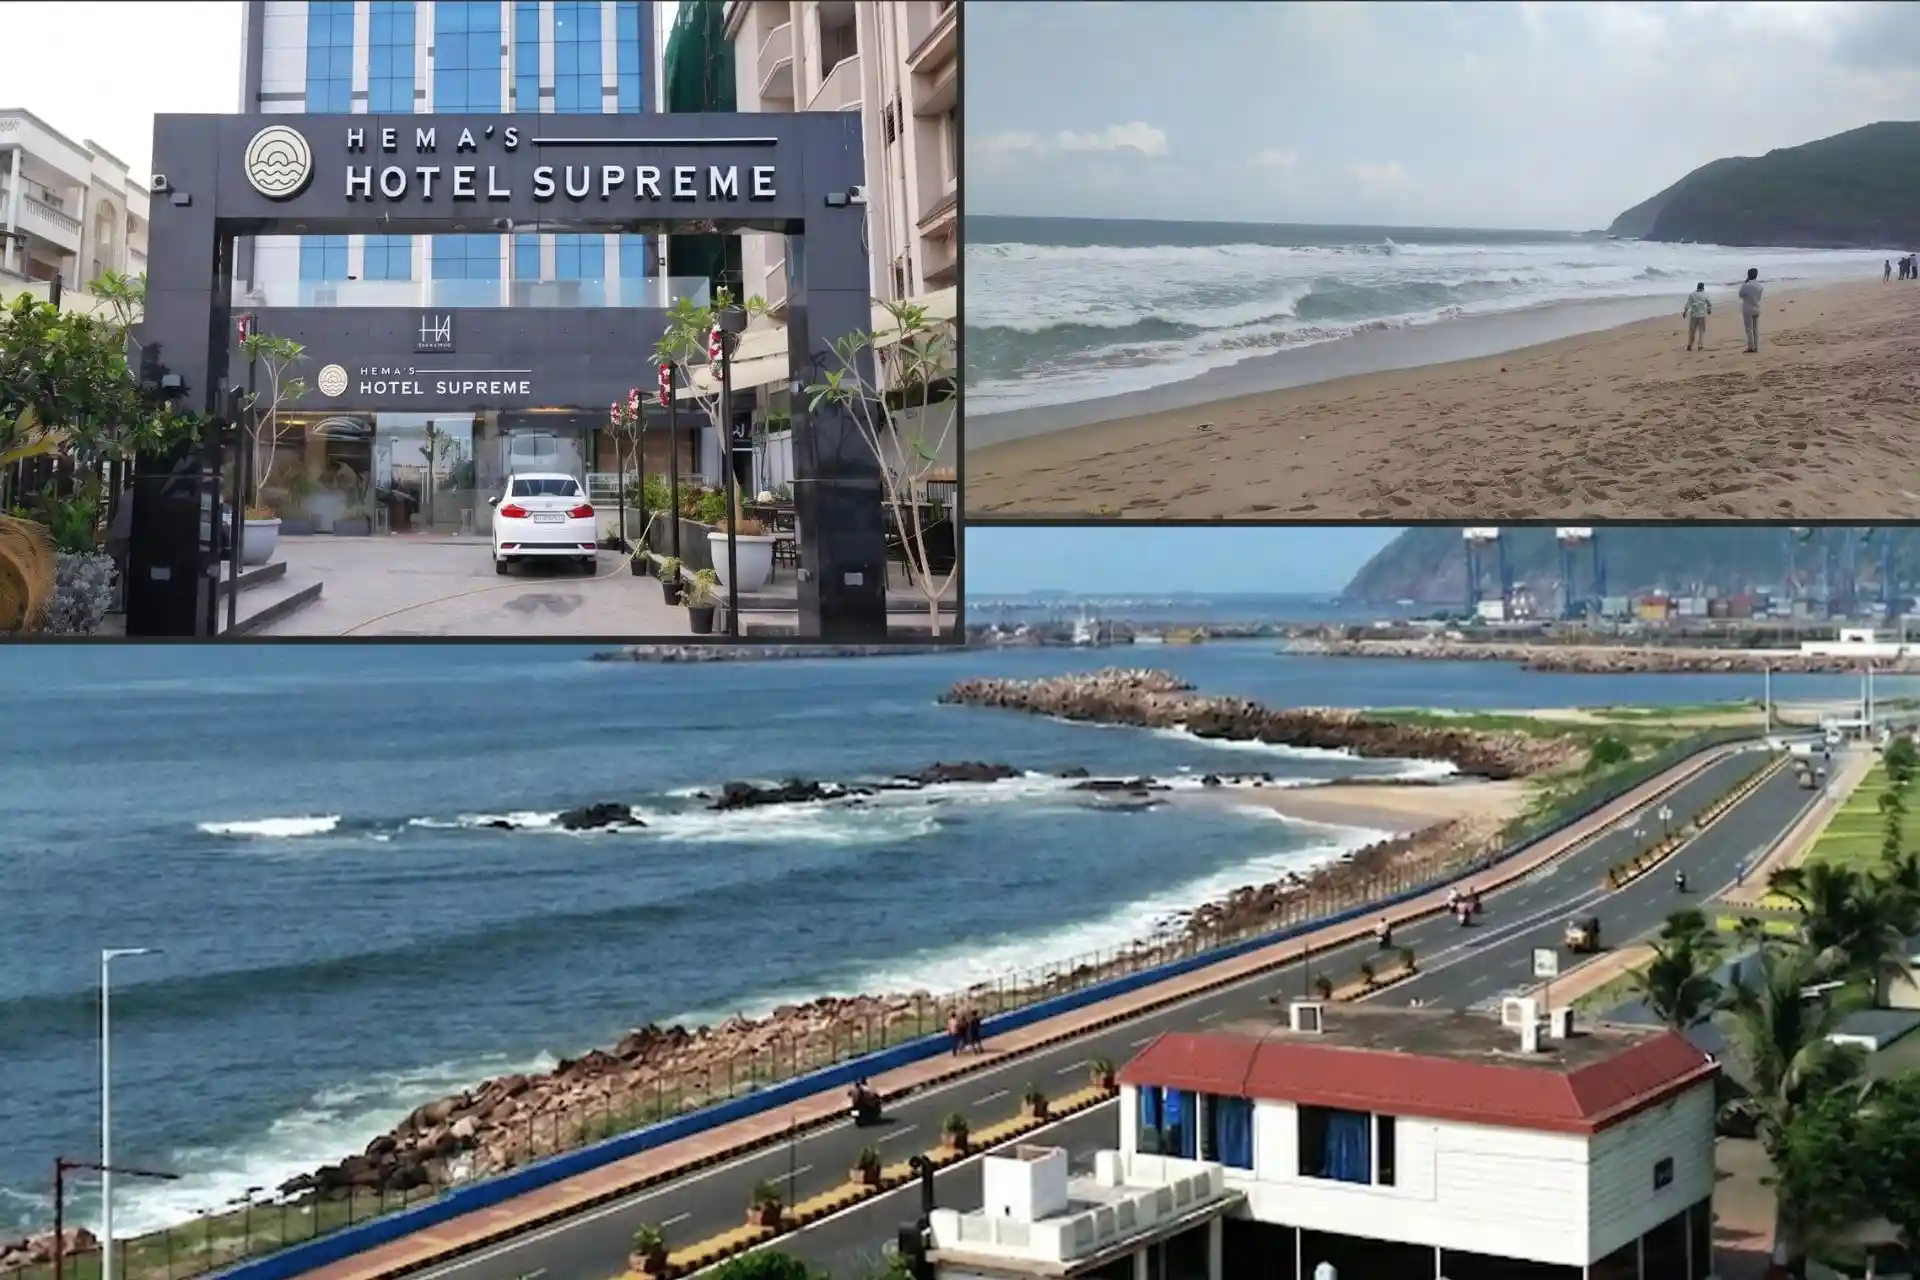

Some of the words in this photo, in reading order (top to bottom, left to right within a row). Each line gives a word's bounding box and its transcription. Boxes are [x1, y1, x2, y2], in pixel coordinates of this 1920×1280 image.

[347, 126, 519, 148] HEMA'S
[345, 165, 511, 197] HOTEL
[532, 165, 778, 197] SUPREME
[360, 366, 415, 376] HEMA'S
[360, 381, 425, 395] HOTEL
[436, 381, 531, 395] SUPREME
